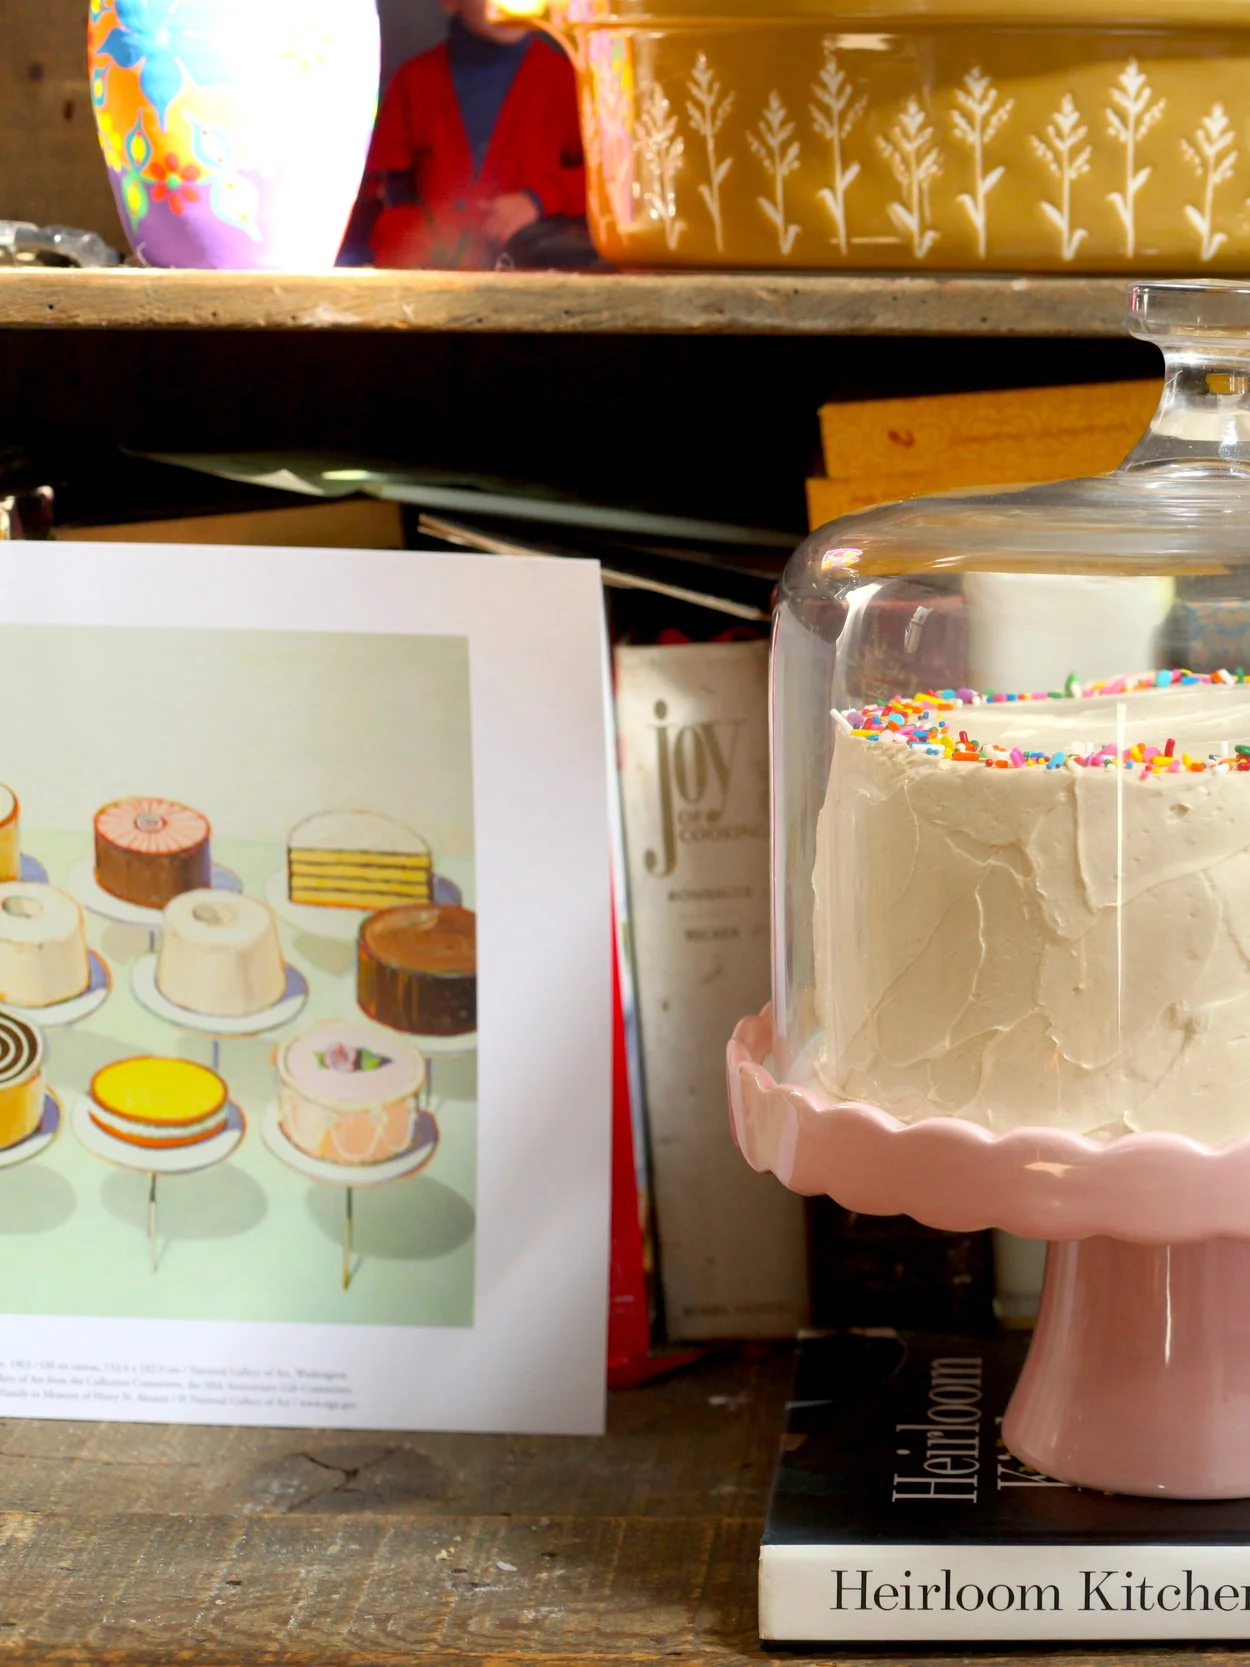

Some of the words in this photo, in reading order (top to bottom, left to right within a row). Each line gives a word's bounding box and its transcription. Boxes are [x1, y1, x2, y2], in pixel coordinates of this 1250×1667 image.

[643, 699, 748, 879] joy
[892, 1357, 983, 1503] Heirloom
[830, 1569, 1062, 1612] Heirloom
